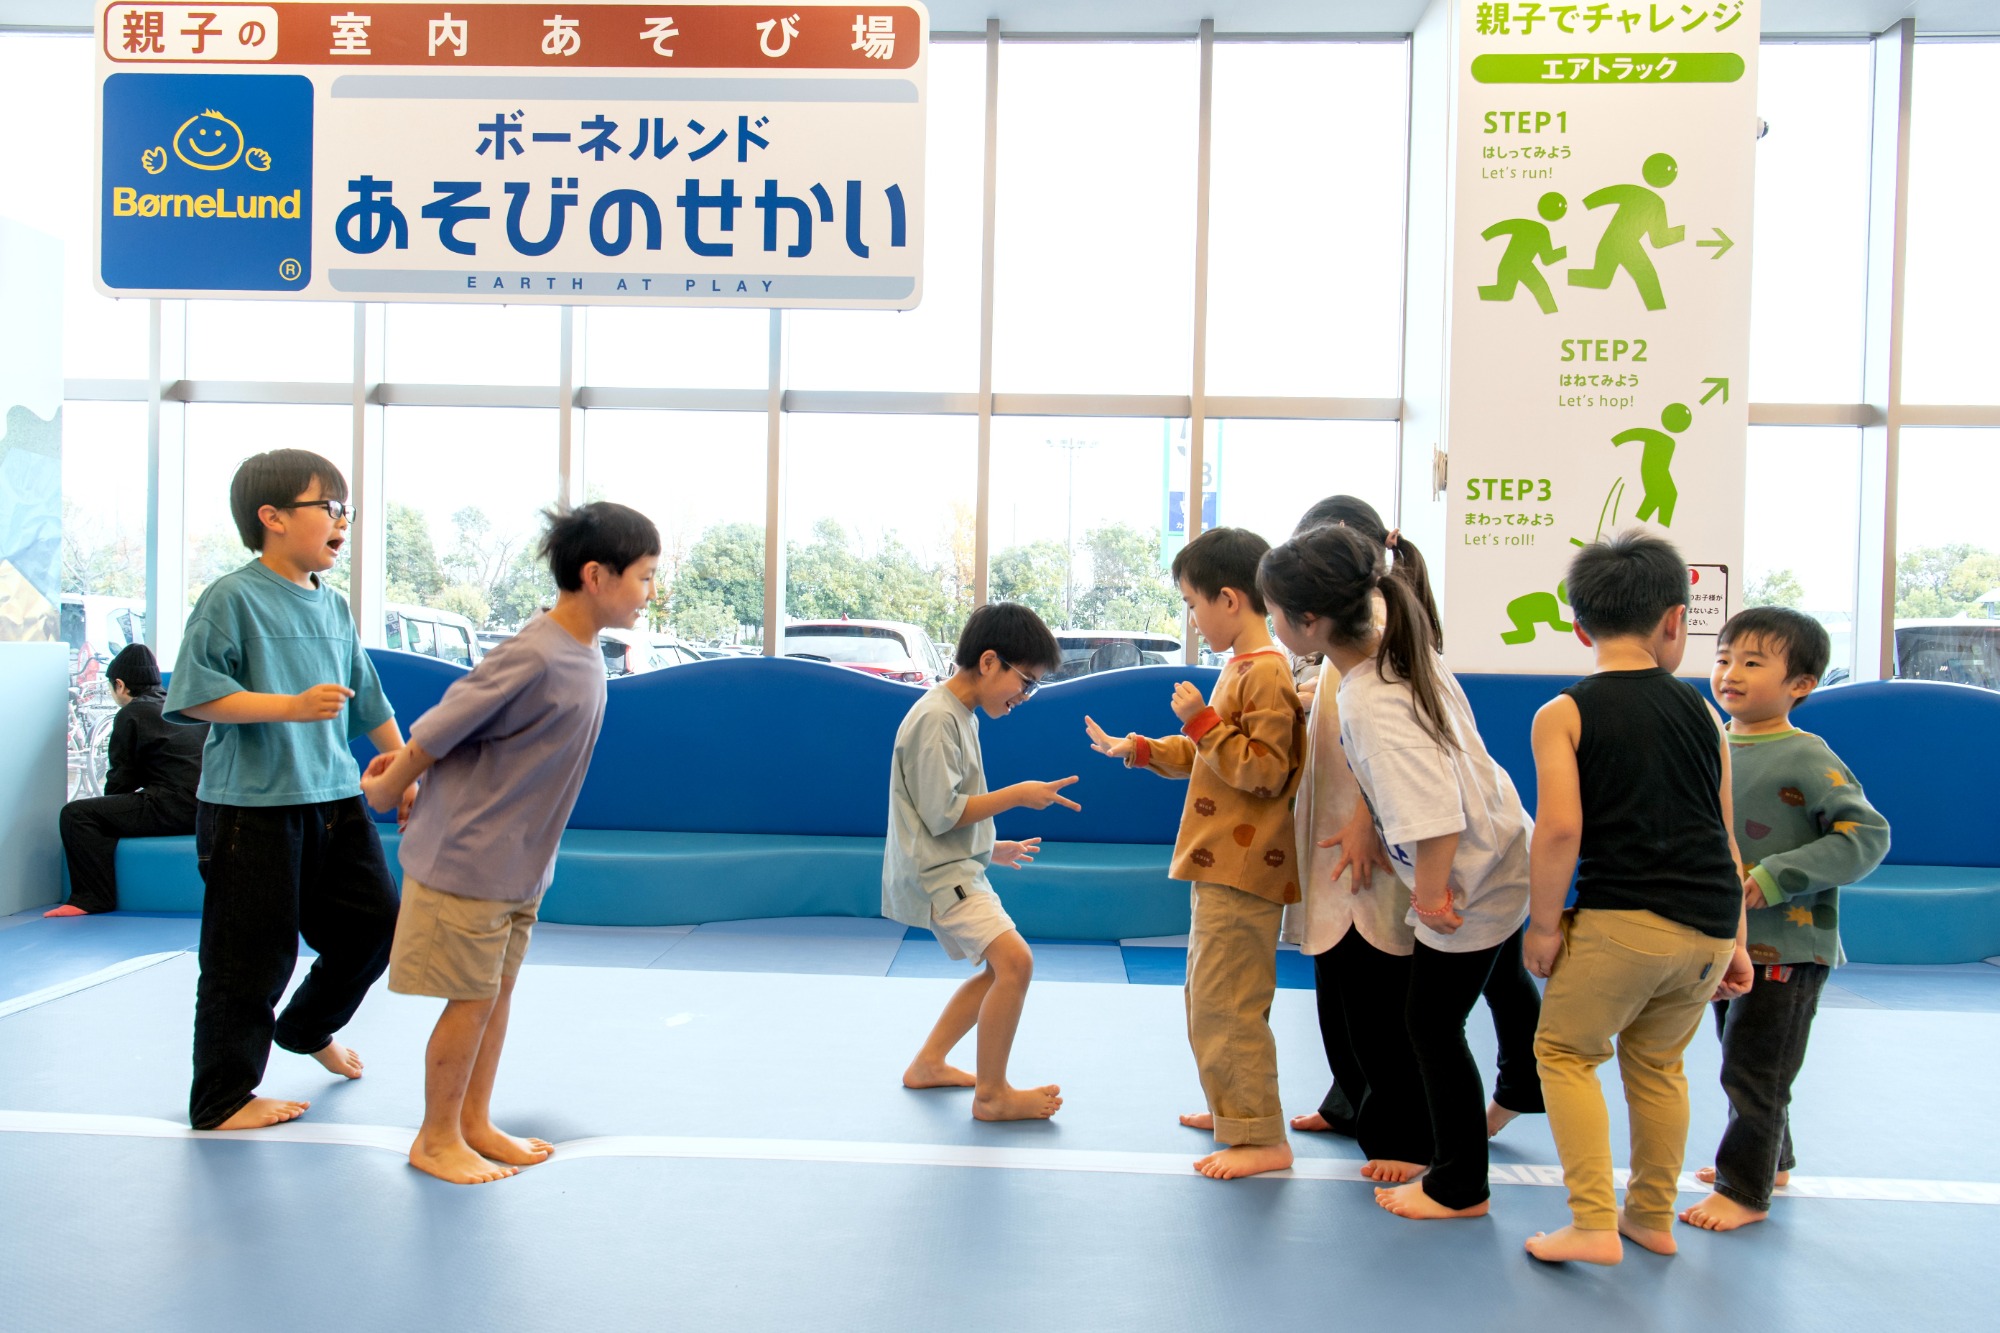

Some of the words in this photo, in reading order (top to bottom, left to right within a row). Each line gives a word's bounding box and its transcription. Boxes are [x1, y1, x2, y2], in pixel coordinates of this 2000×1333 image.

[1476, 0, 1744, 35] 親子でチャレンジ
[122, 10, 267, 54] 親子の
[329, 11, 896, 60] 室内あそび場
[1540, 56, 1678, 80] エアトラック
[475, 108, 770, 163] ボーネルンド
[1482, 145, 1572, 160] はしってみよう
[1522, 167, 1553, 179] run!
[112, 186, 301, 220] BørneLund
[335, 174, 907, 259] あそびのせかい
[467, 276, 584, 290] EARTH
[617, 278, 652, 291] AT
[685, 279, 774, 293] PLAY
[1560, 338, 1648, 362] STEP2
[1559, 373, 1640, 388] はねてみよう
[1599, 394, 1634, 409] hop!
[1466, 478, 1552, 501] STEP3
[1464, 512, 1555, 527] まわってみよう
[1504, 534, 1535, 546] roll!
